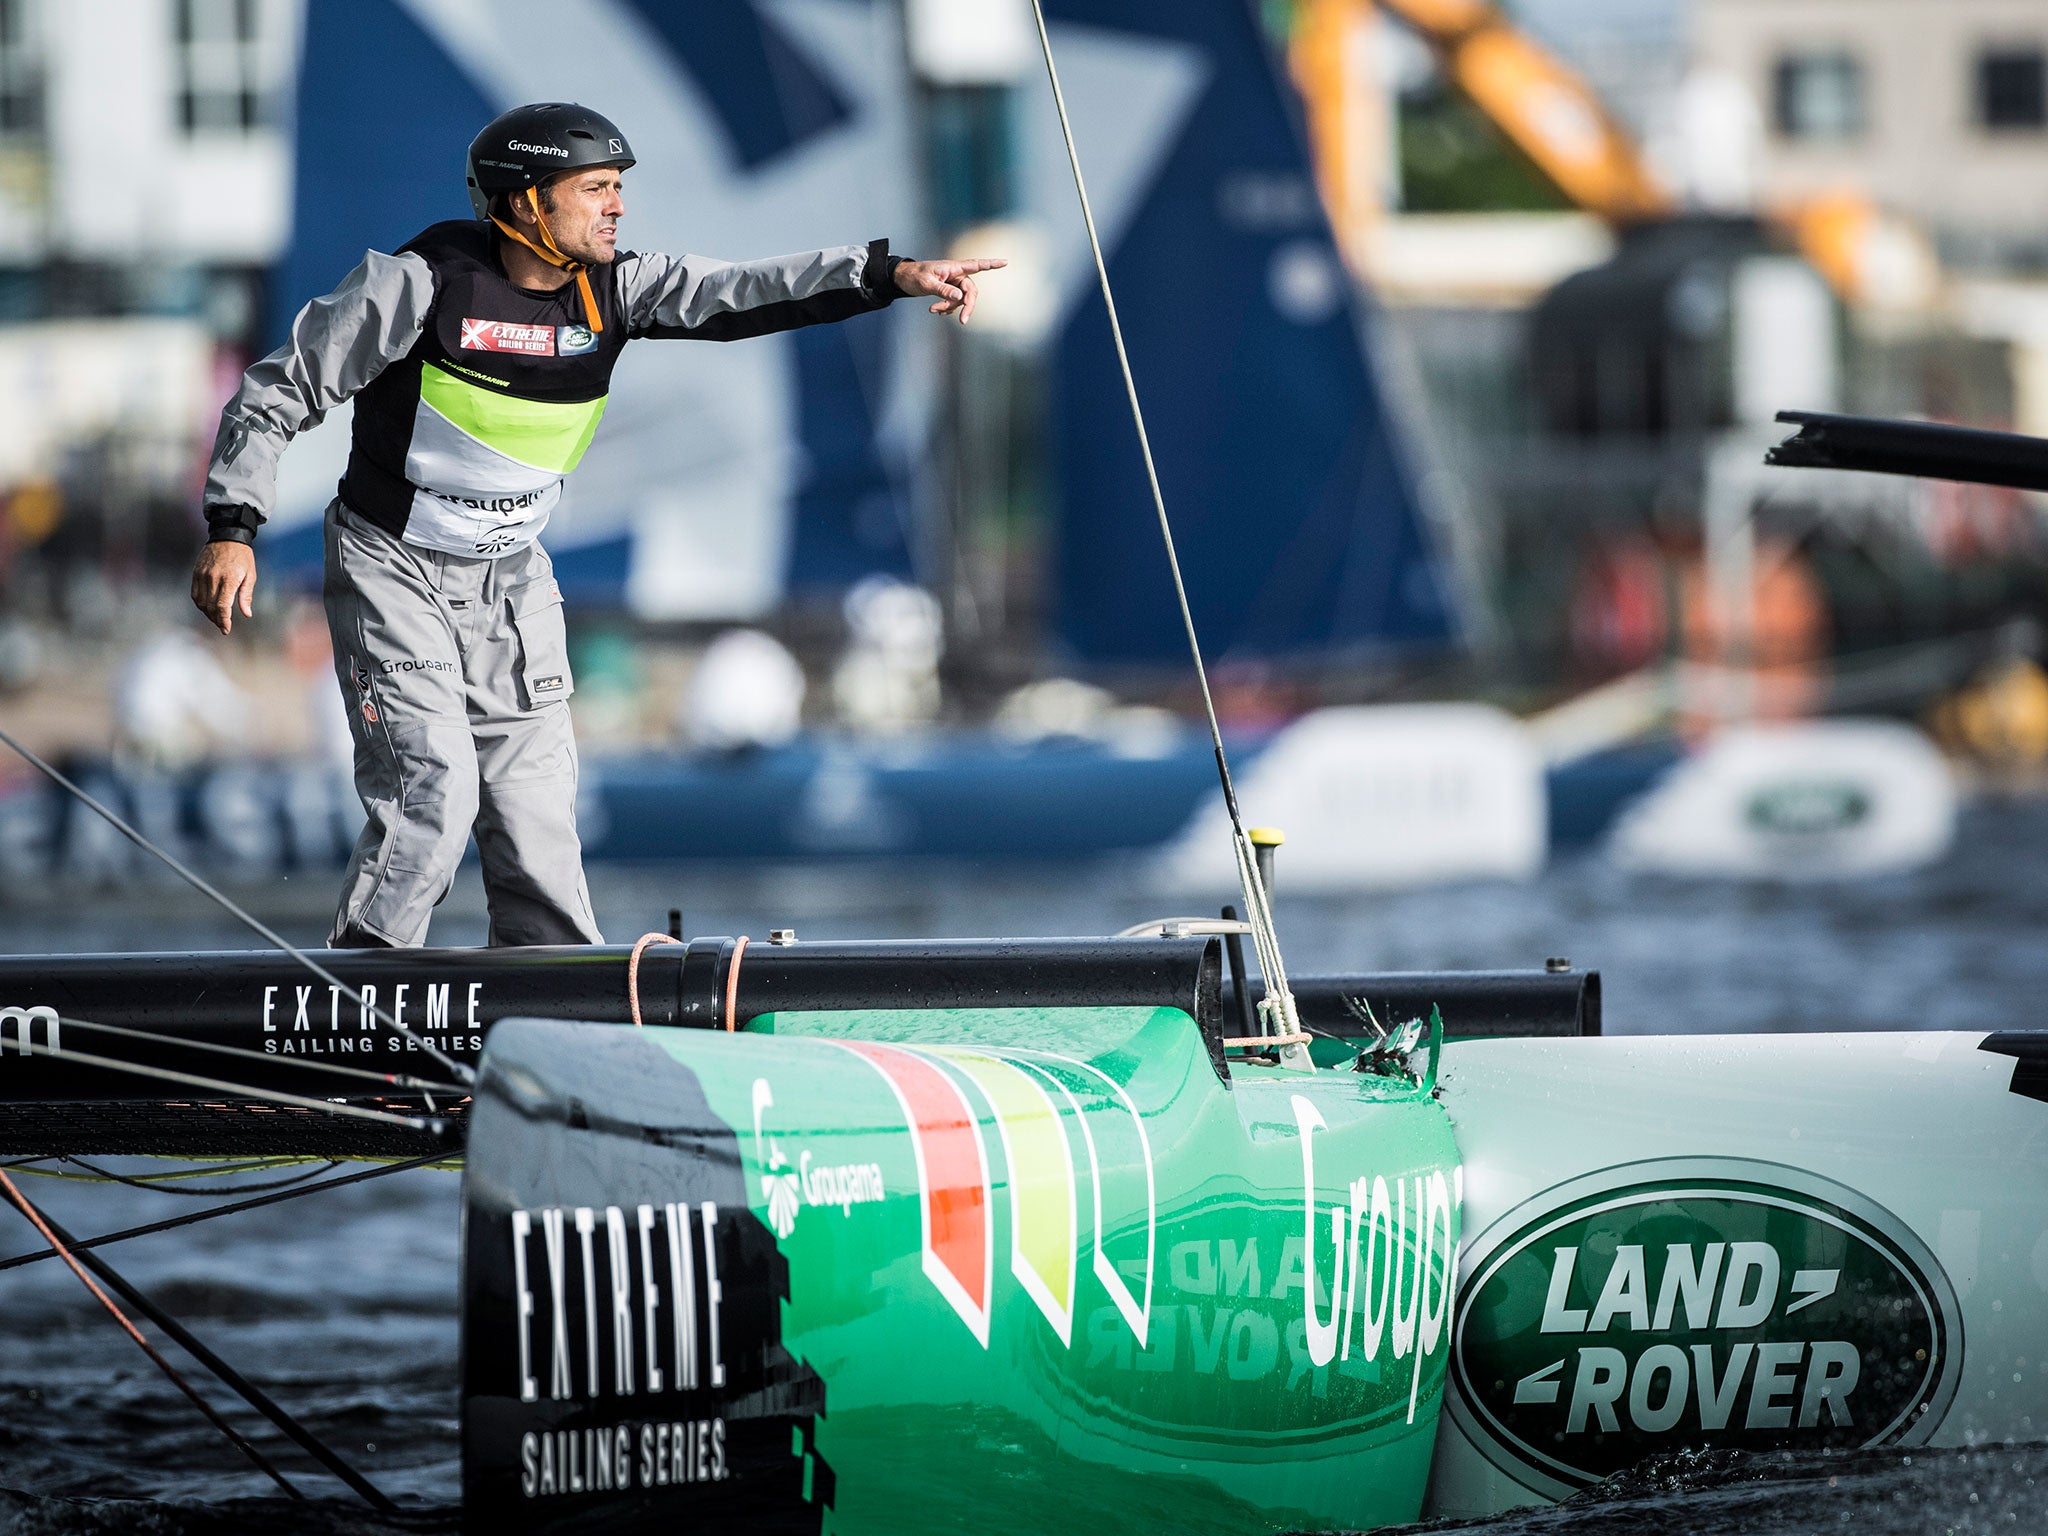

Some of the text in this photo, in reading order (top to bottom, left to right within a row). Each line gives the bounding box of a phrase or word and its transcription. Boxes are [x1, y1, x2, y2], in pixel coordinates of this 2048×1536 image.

[508, 139, 569, 158] Groupama
[491, 326, 552, 342] EXTREME
[498, 339, 546, 352] SAILING SERIES
[263, 982, 483, 1032] EXTREME
[264, 1035, 482, 1054] SAILING SERIES
[800, 1150, 884, 1218] Groupama
[512, 1200, 726, 1402] EXTREME
[1540, 1241, 1781, 1333] LAND
[1566, 1340, 1861, 1434] ROVER
[522, 1425, 631, 1498] SAILING
